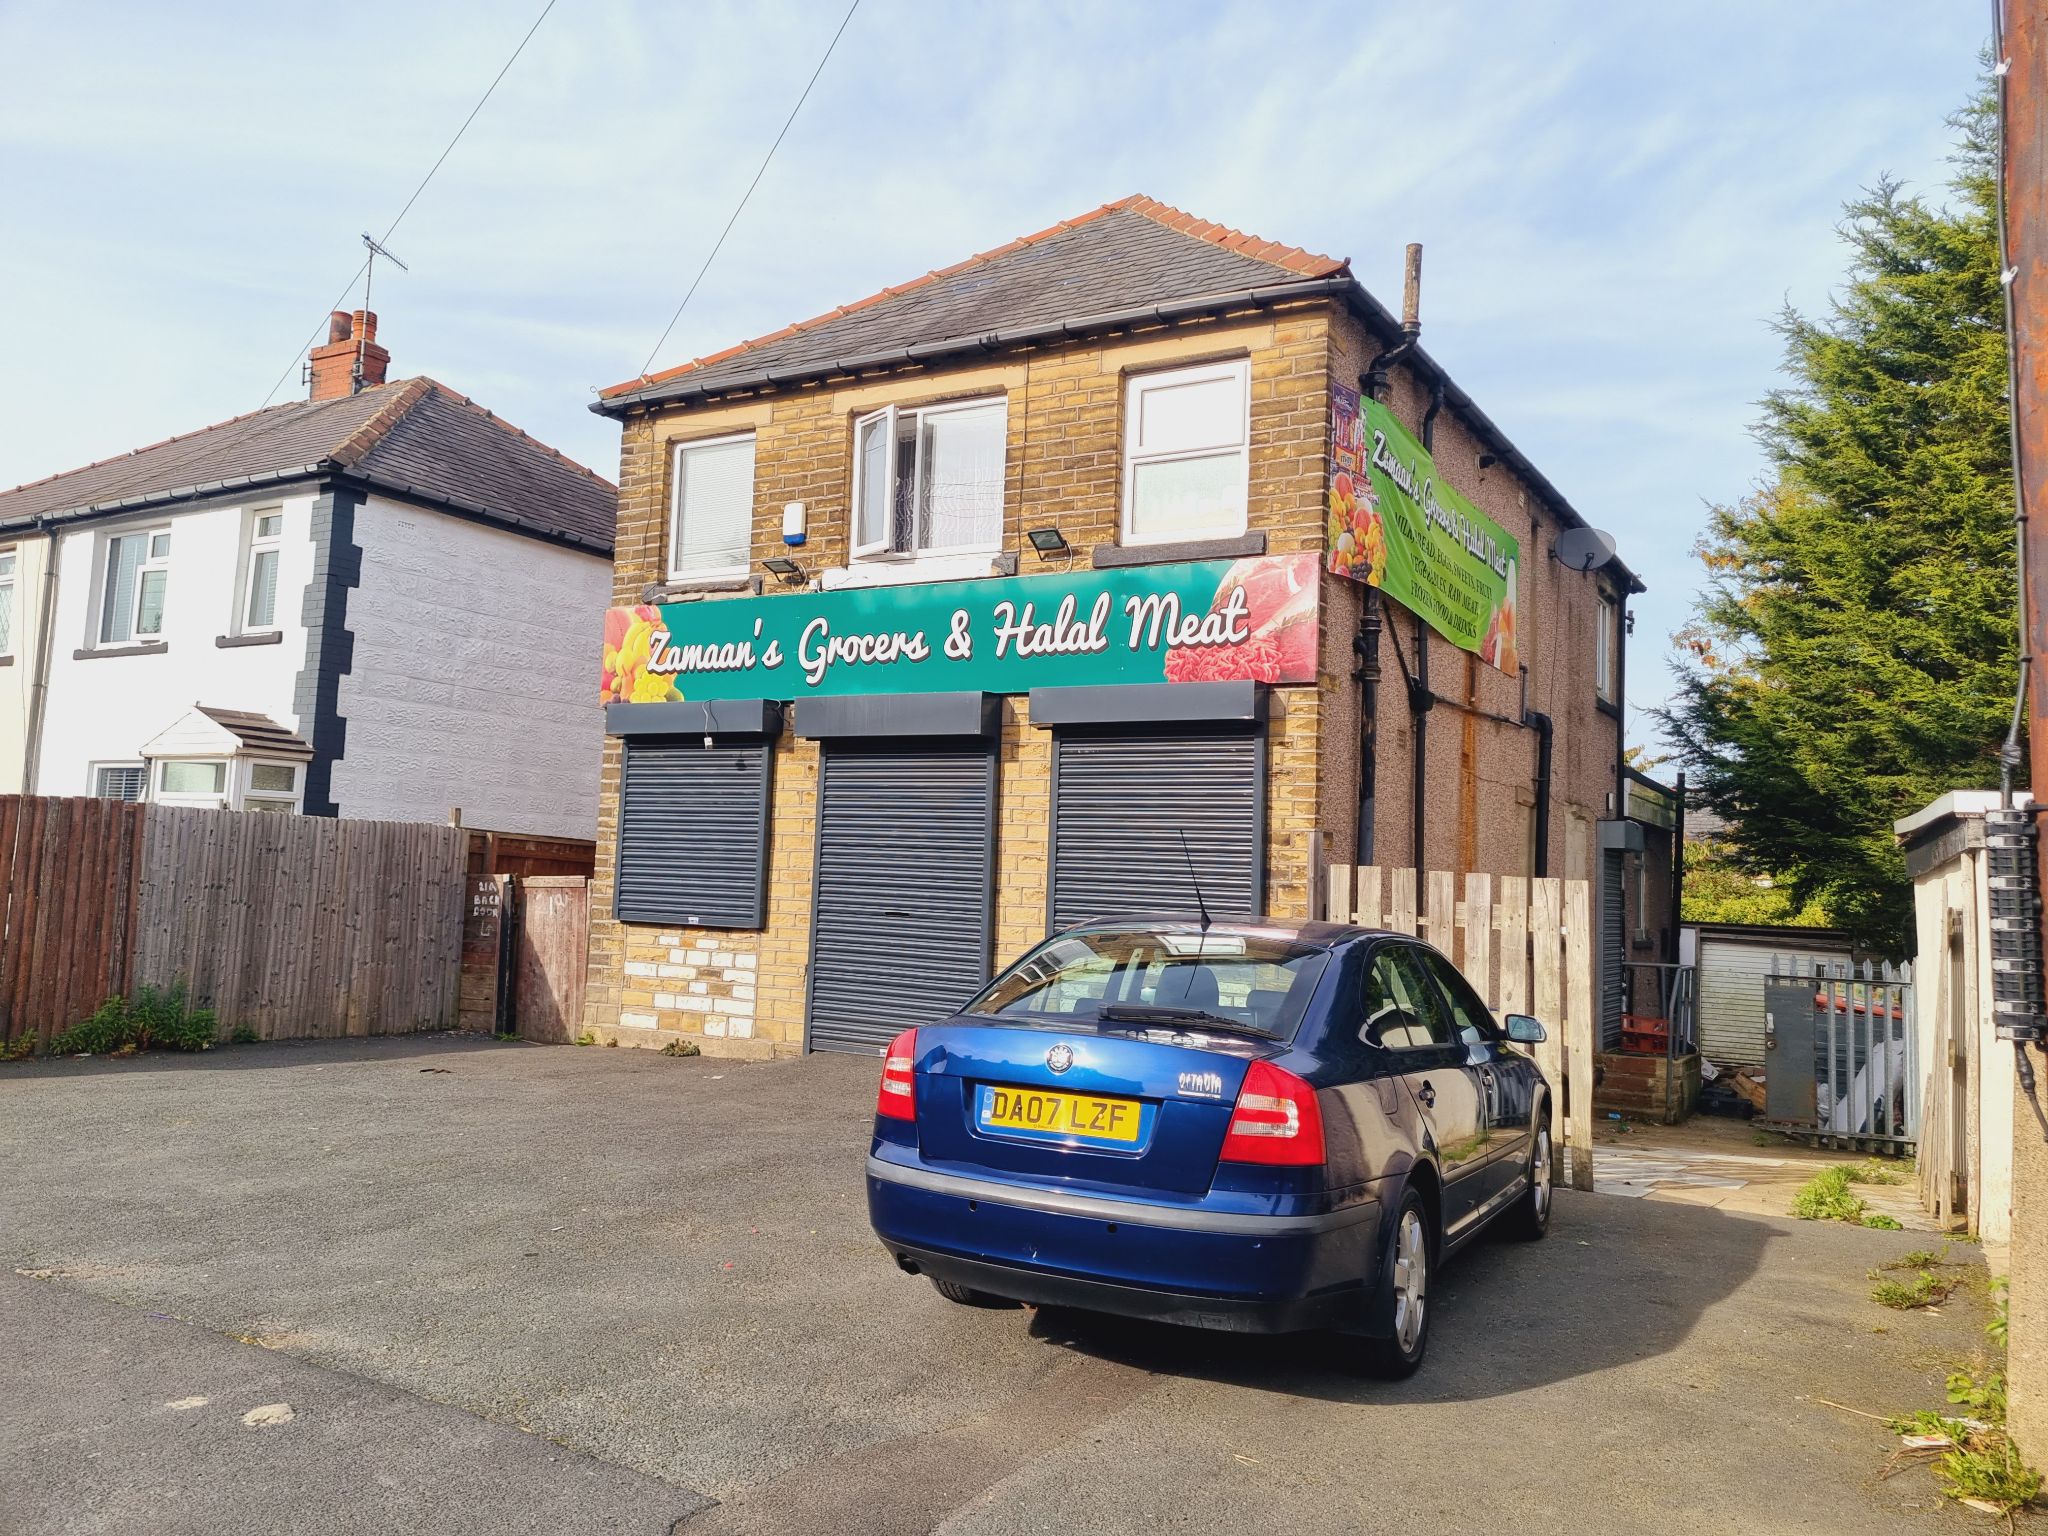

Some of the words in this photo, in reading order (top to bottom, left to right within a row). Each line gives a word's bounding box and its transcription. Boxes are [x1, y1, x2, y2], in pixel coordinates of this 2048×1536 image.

[1460, 513, 1486, 562] Halal
[1487, 536, 1506, 578] Meat
[646, 617, 783, 675] Zamaan's
[799, 616, 929, 686] Grocers
[943, 608, 972, 661] &
[993, 591, 1112, 659] Halal
[1125, 585, 1251, 652] Meat
[991, 1091, 1062, 1126] DA07
[1070, 1100, 1128, 1132] LZF
